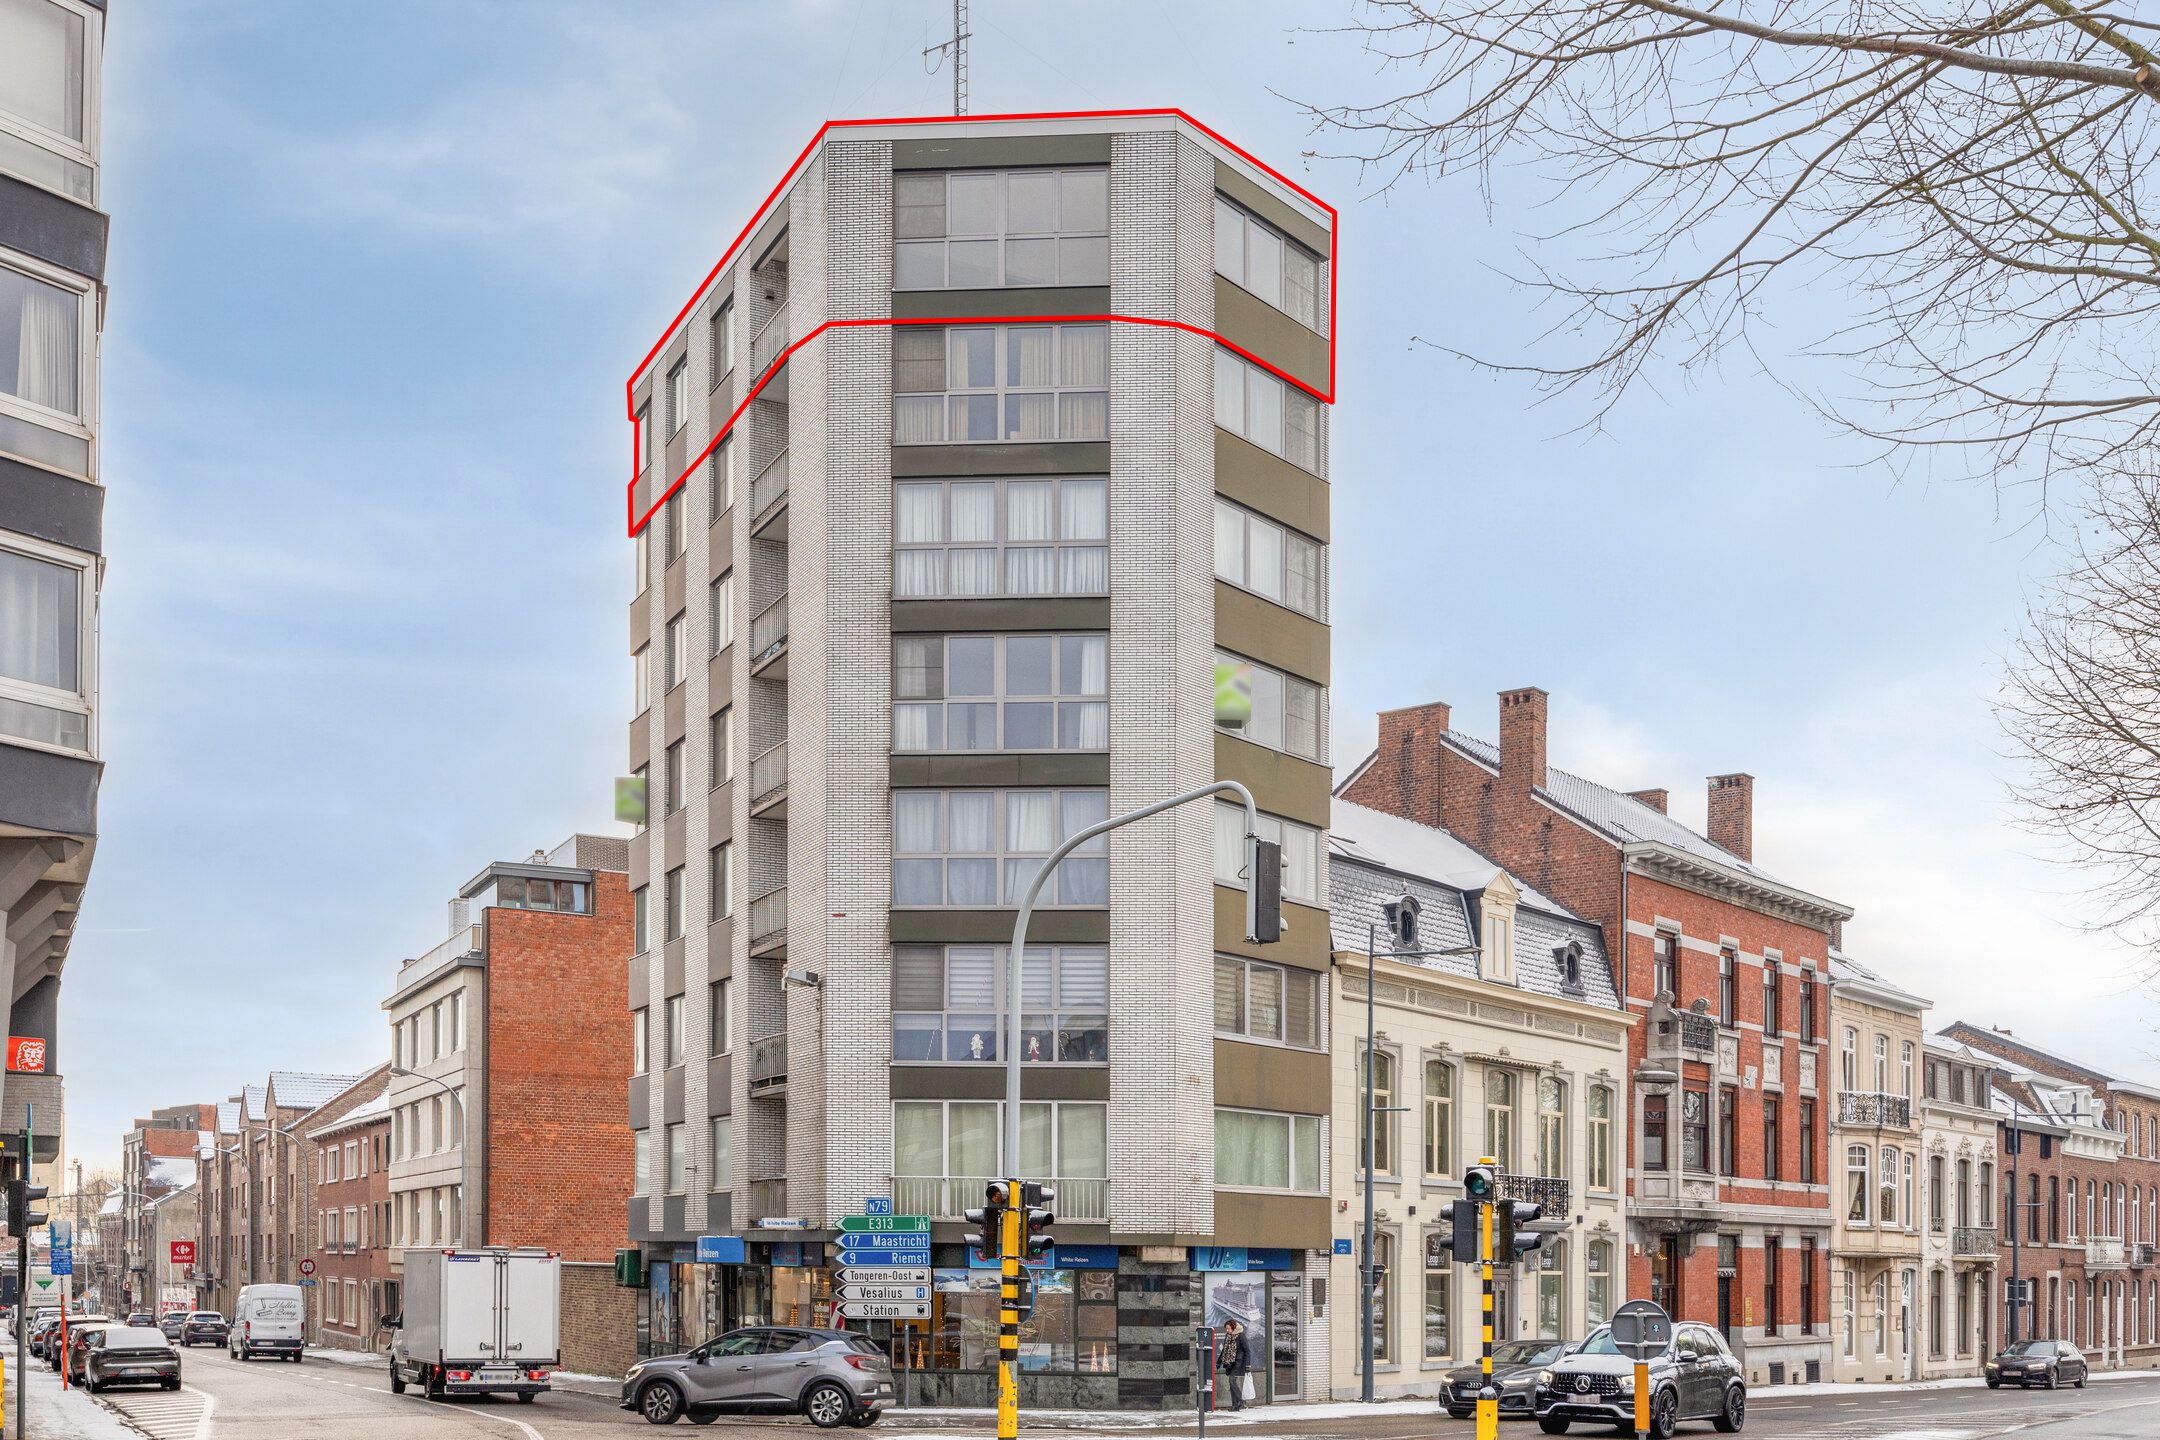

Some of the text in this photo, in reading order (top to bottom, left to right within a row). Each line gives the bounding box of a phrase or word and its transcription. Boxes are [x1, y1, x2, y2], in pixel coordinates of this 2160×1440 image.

[869, 1201, 889, 1213] N79
[868, 1218, 894, 1230] E313
[849, 1235, 927, 1247] 17 Maastricht
[849, 1252, 927, 1264] 9 Riemst
[850, 1271, 912, 1282] Tongeren-Oost
[860, 1287, 903, 1298] Vesalius
[863, 1304, 900, 1316] Station
